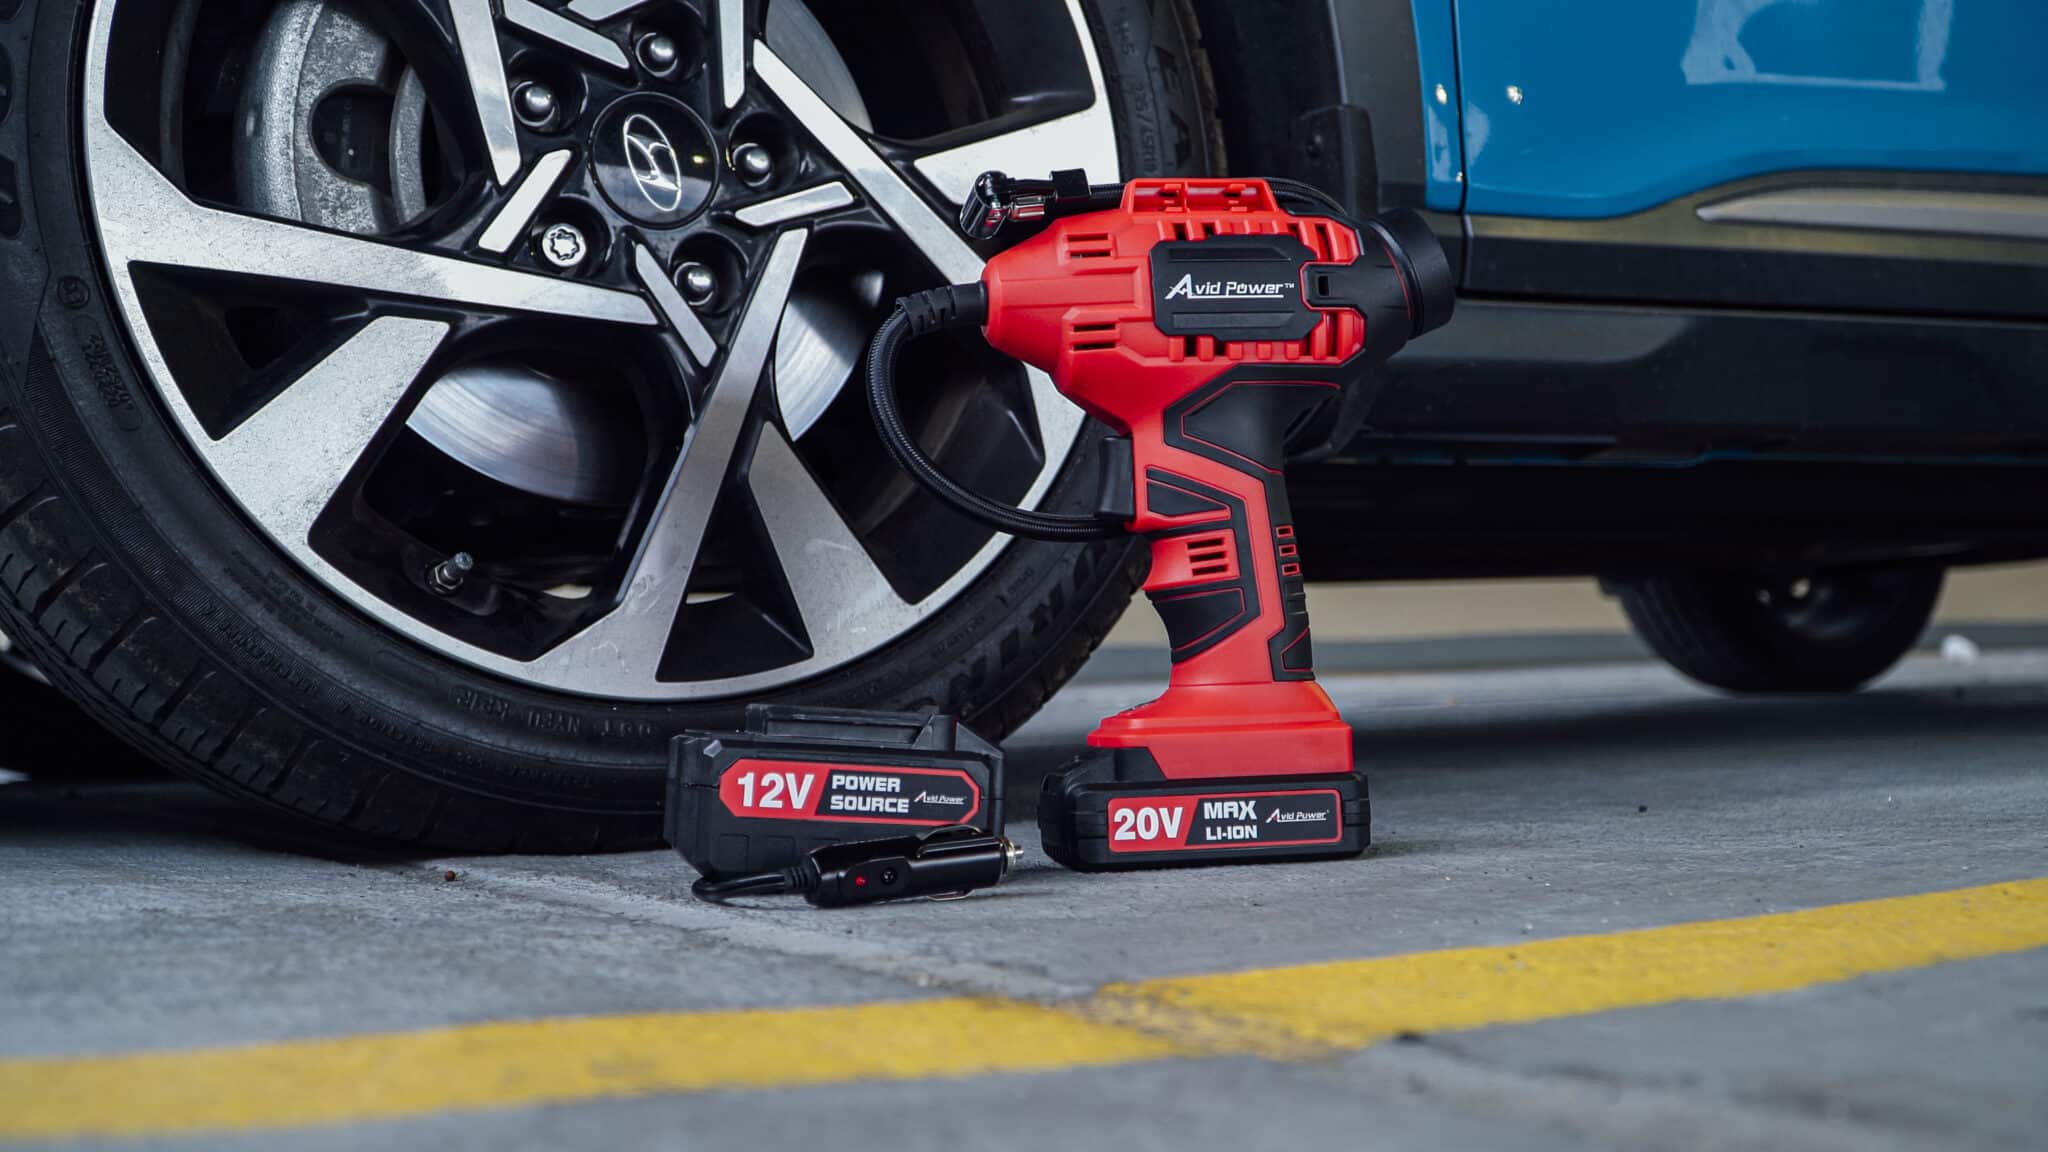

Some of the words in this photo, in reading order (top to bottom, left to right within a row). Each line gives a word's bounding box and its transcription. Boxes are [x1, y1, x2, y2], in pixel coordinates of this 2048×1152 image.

[1164, 273, 1221, 299] Avid
[737, 771, 815, 810] 12V
[831, 775, 901, 793] POWER
[830, 795, 910, 814] SOURCE
[1203, 800, 1258, 821] MAX
[1113, 806, 1185, 841] 20V
[1265, 808, 1295, 823] Avid
[1205, 825, 1258, 841] LI-ION
